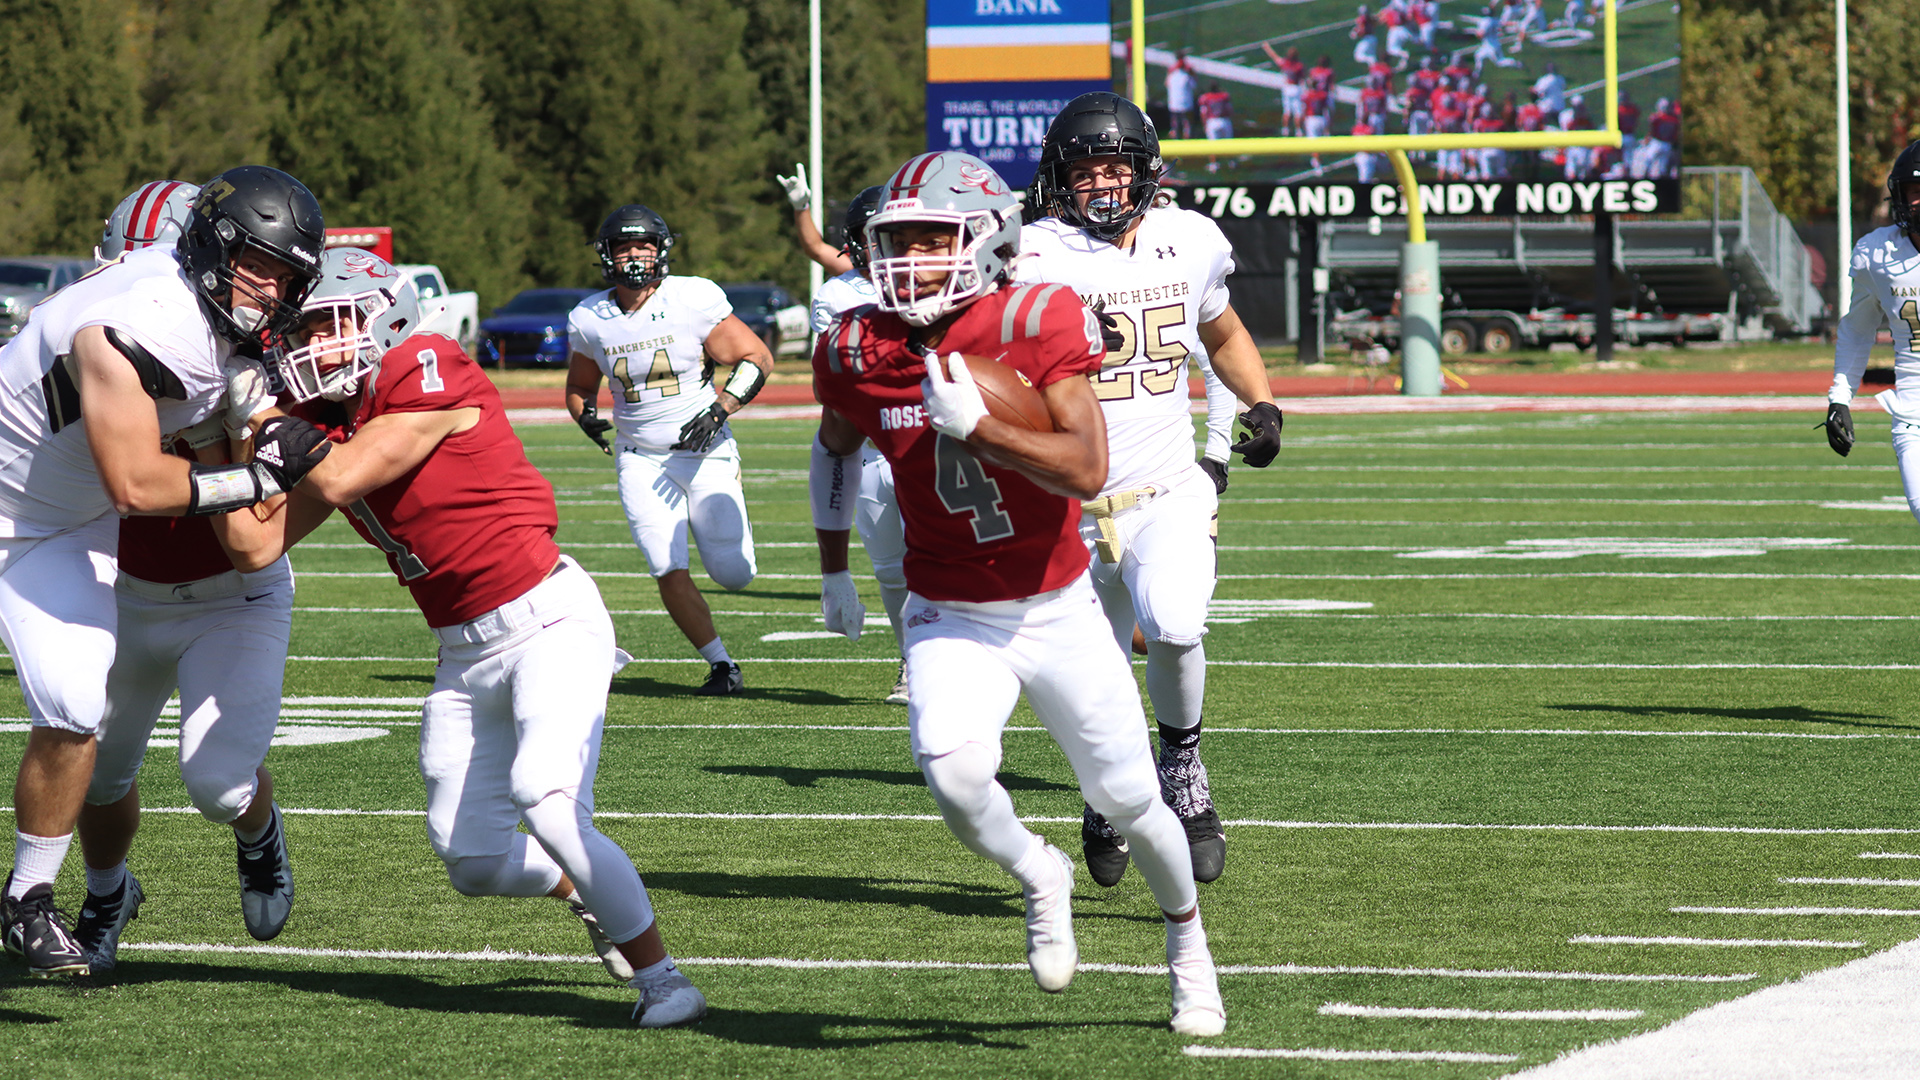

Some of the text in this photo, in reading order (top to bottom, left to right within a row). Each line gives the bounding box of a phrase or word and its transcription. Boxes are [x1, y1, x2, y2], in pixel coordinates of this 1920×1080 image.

[976, 0, 1061, 16] BANK
[990, 100, 1016, 115] THE
[1267, 185, 1355, 216] AND
[1516, 180, 1658, 214] NOYES
[1890, 286, 1920, 297] MAN
[602, 334, 675, 357] MANCHESTER
[1088, 302, 1190, 402] 25
[416, 348, 445, 394] 1
[612, 348, 681, 404] 14
[255, 450, 285, 468] adidas
[934, 430, 1015, 544] 4
